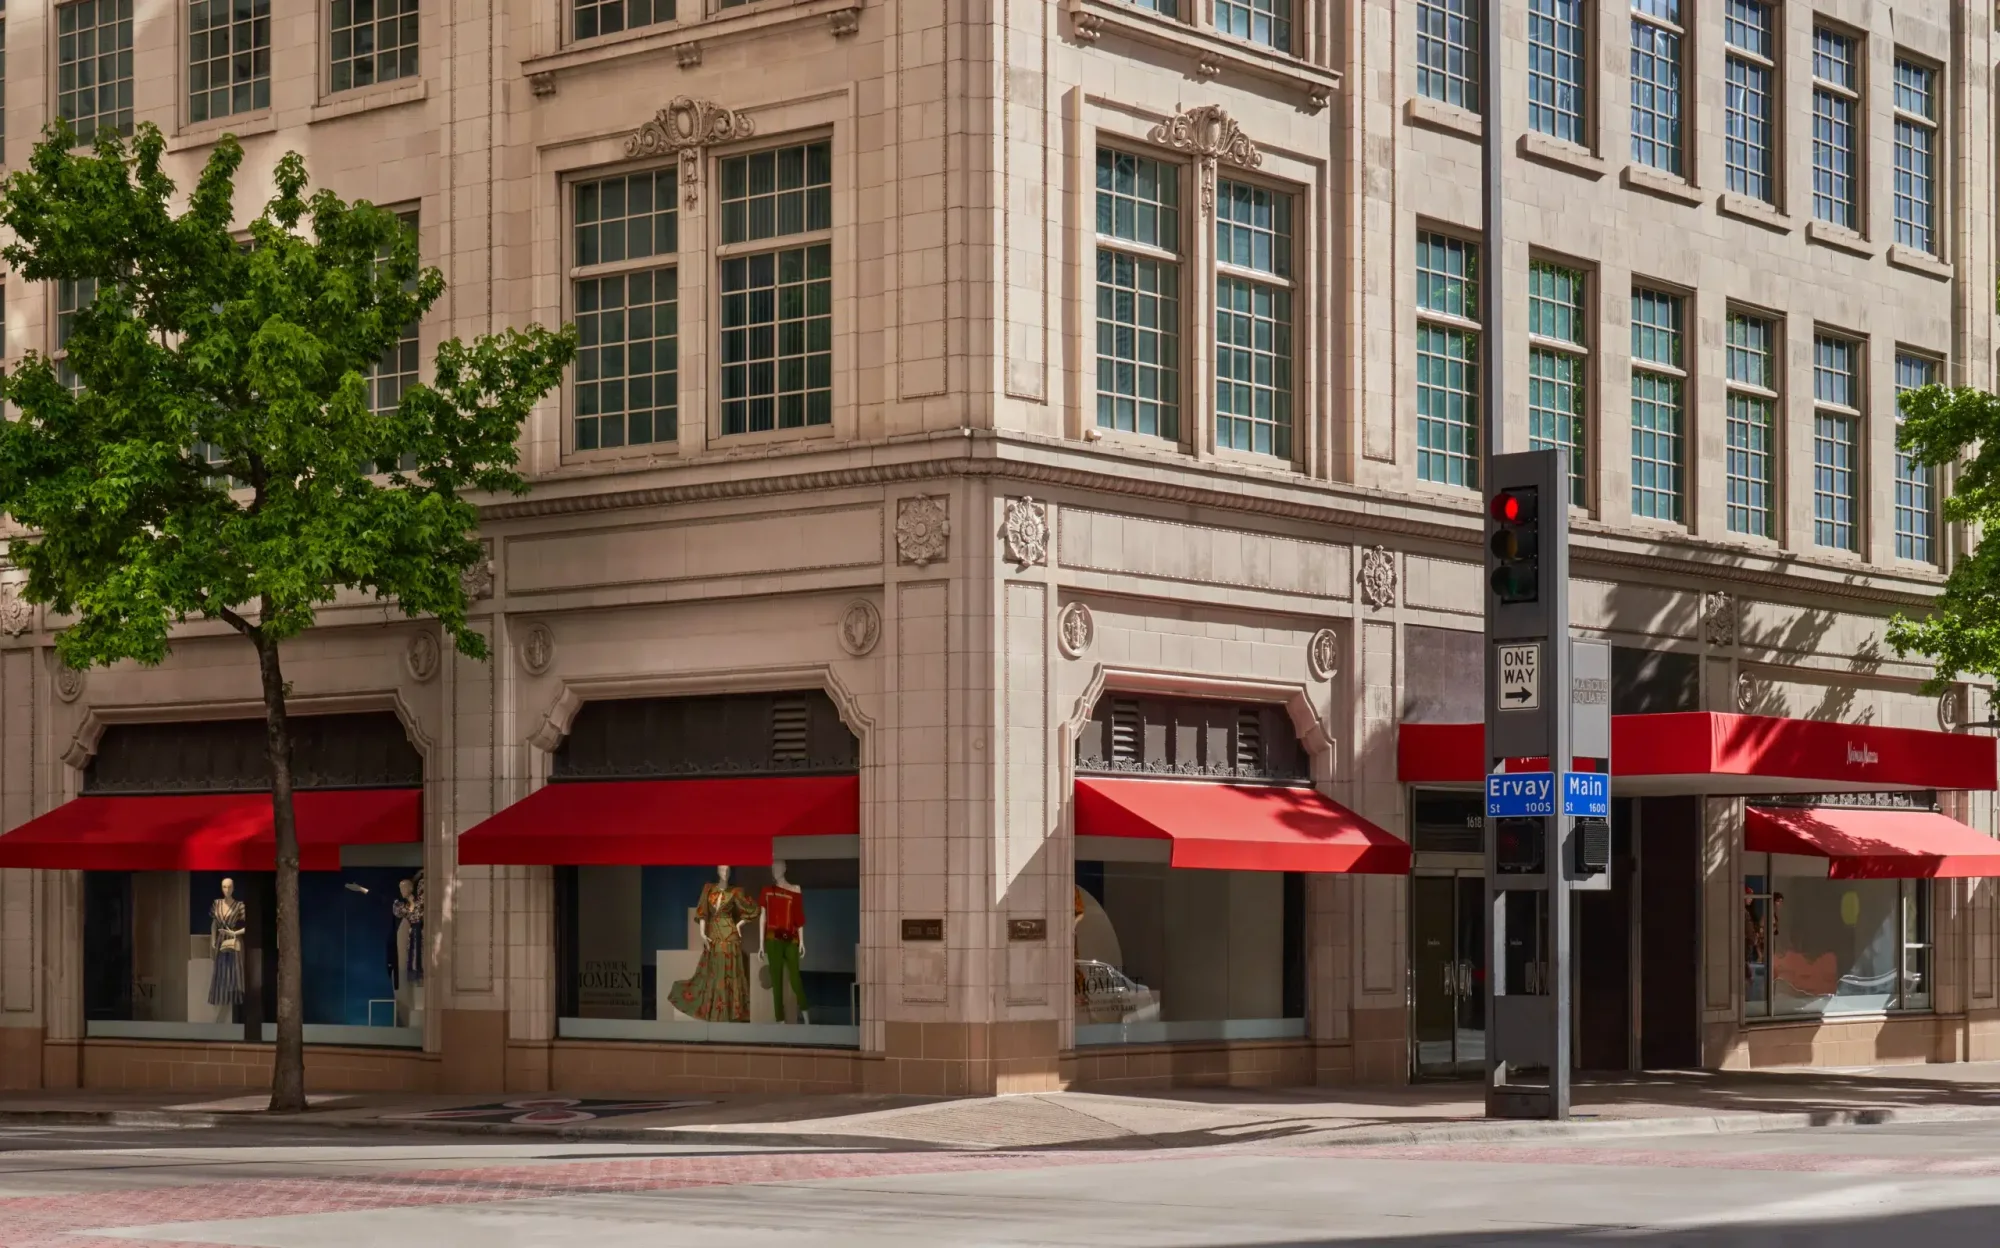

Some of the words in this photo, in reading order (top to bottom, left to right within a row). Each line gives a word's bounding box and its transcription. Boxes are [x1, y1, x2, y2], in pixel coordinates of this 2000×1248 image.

[1504, 651, 1534, 666] ONE
[1504, 668, 1535, 684] WAY
[1490, 779, 1550, 800] Ervay
[1570, 776, 1602, 796] Main
[1490, 803, 1501, 813] St
[1525, 802, 1551, 812] 100S
[1565, 802, 1574, 812] St
[1589, 803, 1606, 813] 1600
[1466, 816, 1482, 828] 1618
